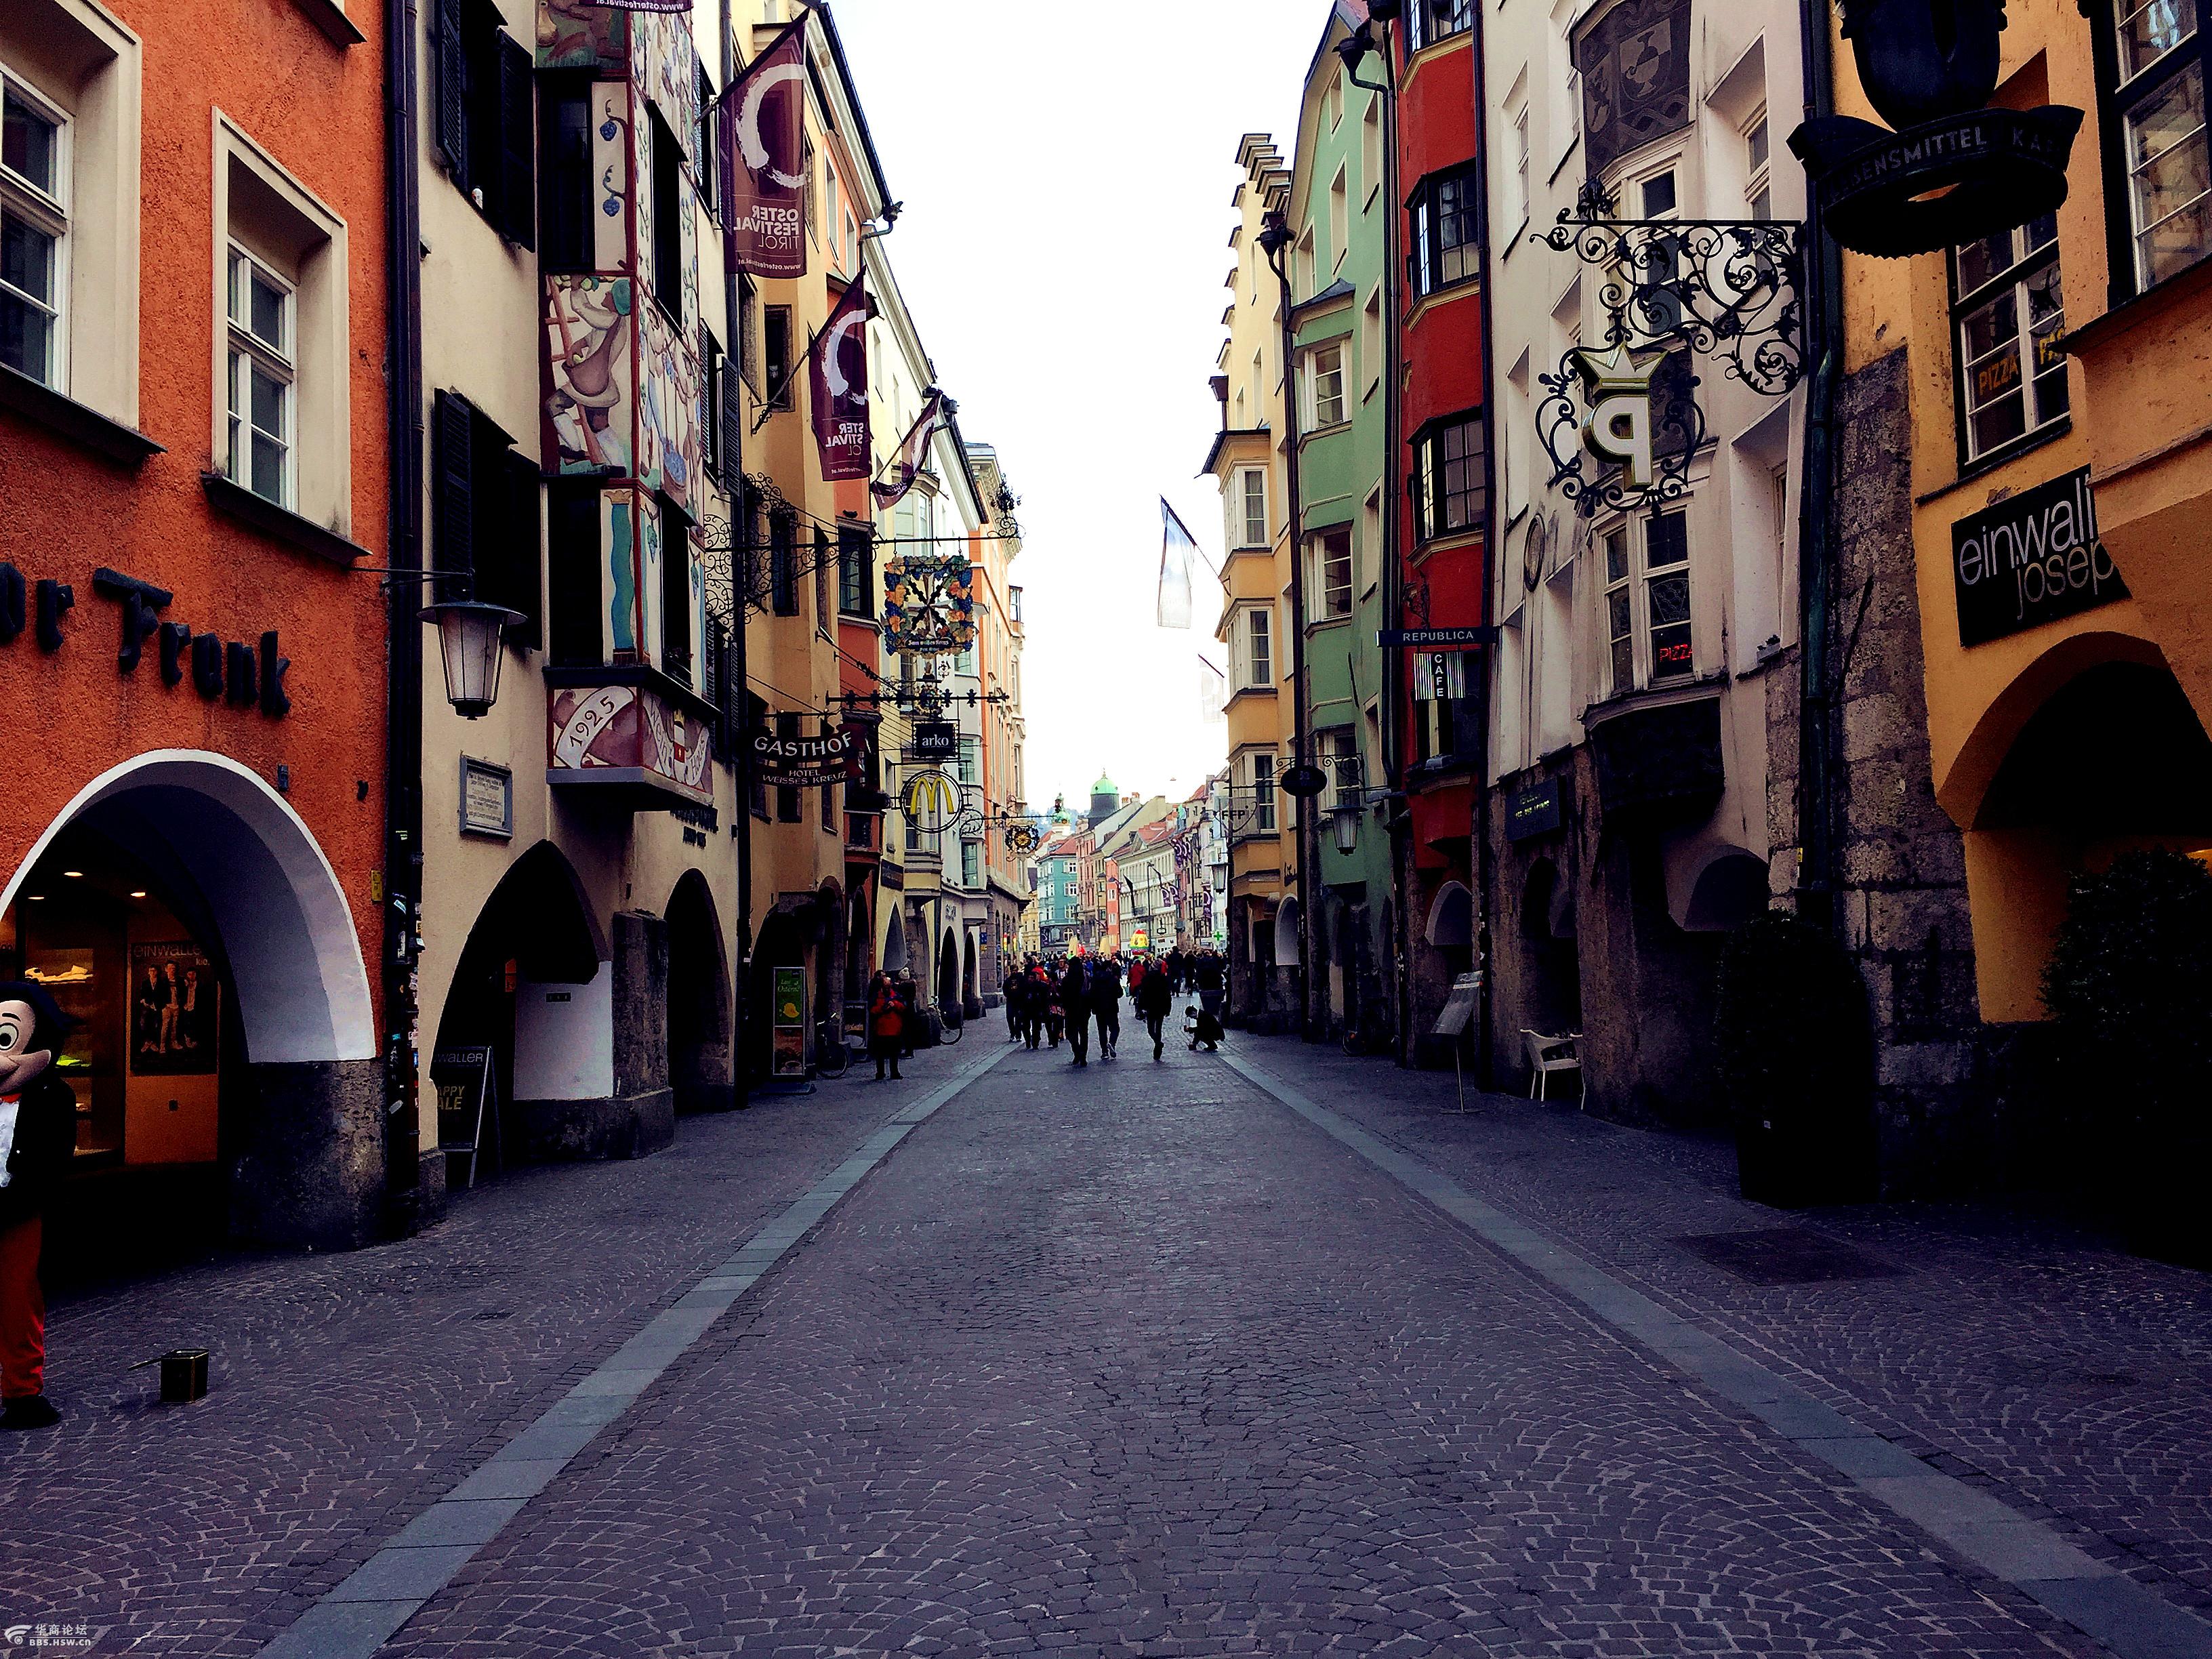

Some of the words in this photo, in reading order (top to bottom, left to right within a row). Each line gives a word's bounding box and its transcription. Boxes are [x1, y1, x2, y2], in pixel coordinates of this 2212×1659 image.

[1837, 125, 1987, 195] BENSMITTEL
[1403, 630, 1474, 642] REPUBLICA
[569, 695, 615, 748] 1925
[754, 731, 852, 757] GASTHOF
[922, 734, 949, 746] arko
[763, 775, 808, 785] WEISSES
[813, 771, 848, 784] KREUZ
[789, 769, 821, 777] HOTEL
